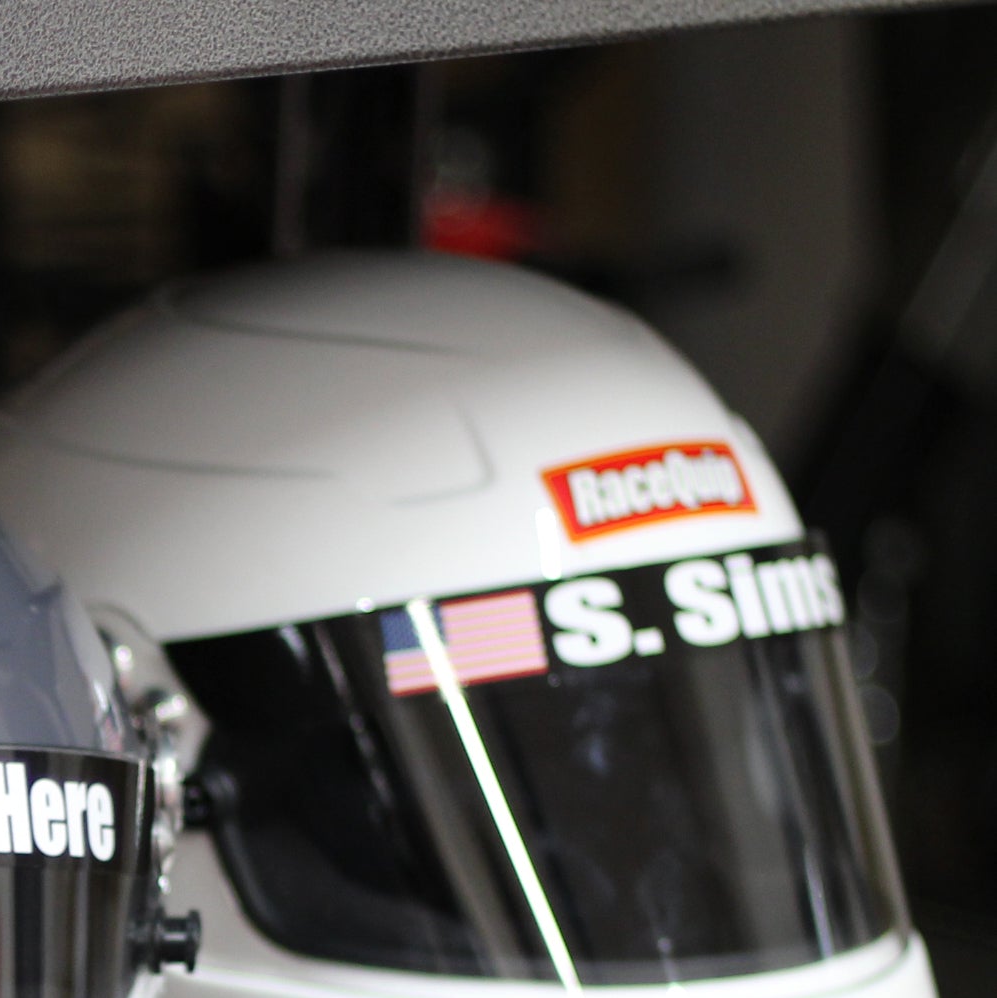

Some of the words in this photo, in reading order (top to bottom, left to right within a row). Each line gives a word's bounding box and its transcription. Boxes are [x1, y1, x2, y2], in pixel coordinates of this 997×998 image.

[567, 449, 744, 528] RaceQuip
[545, 576, 665, 668] S.
[665, 553, 845, 647] Sims
